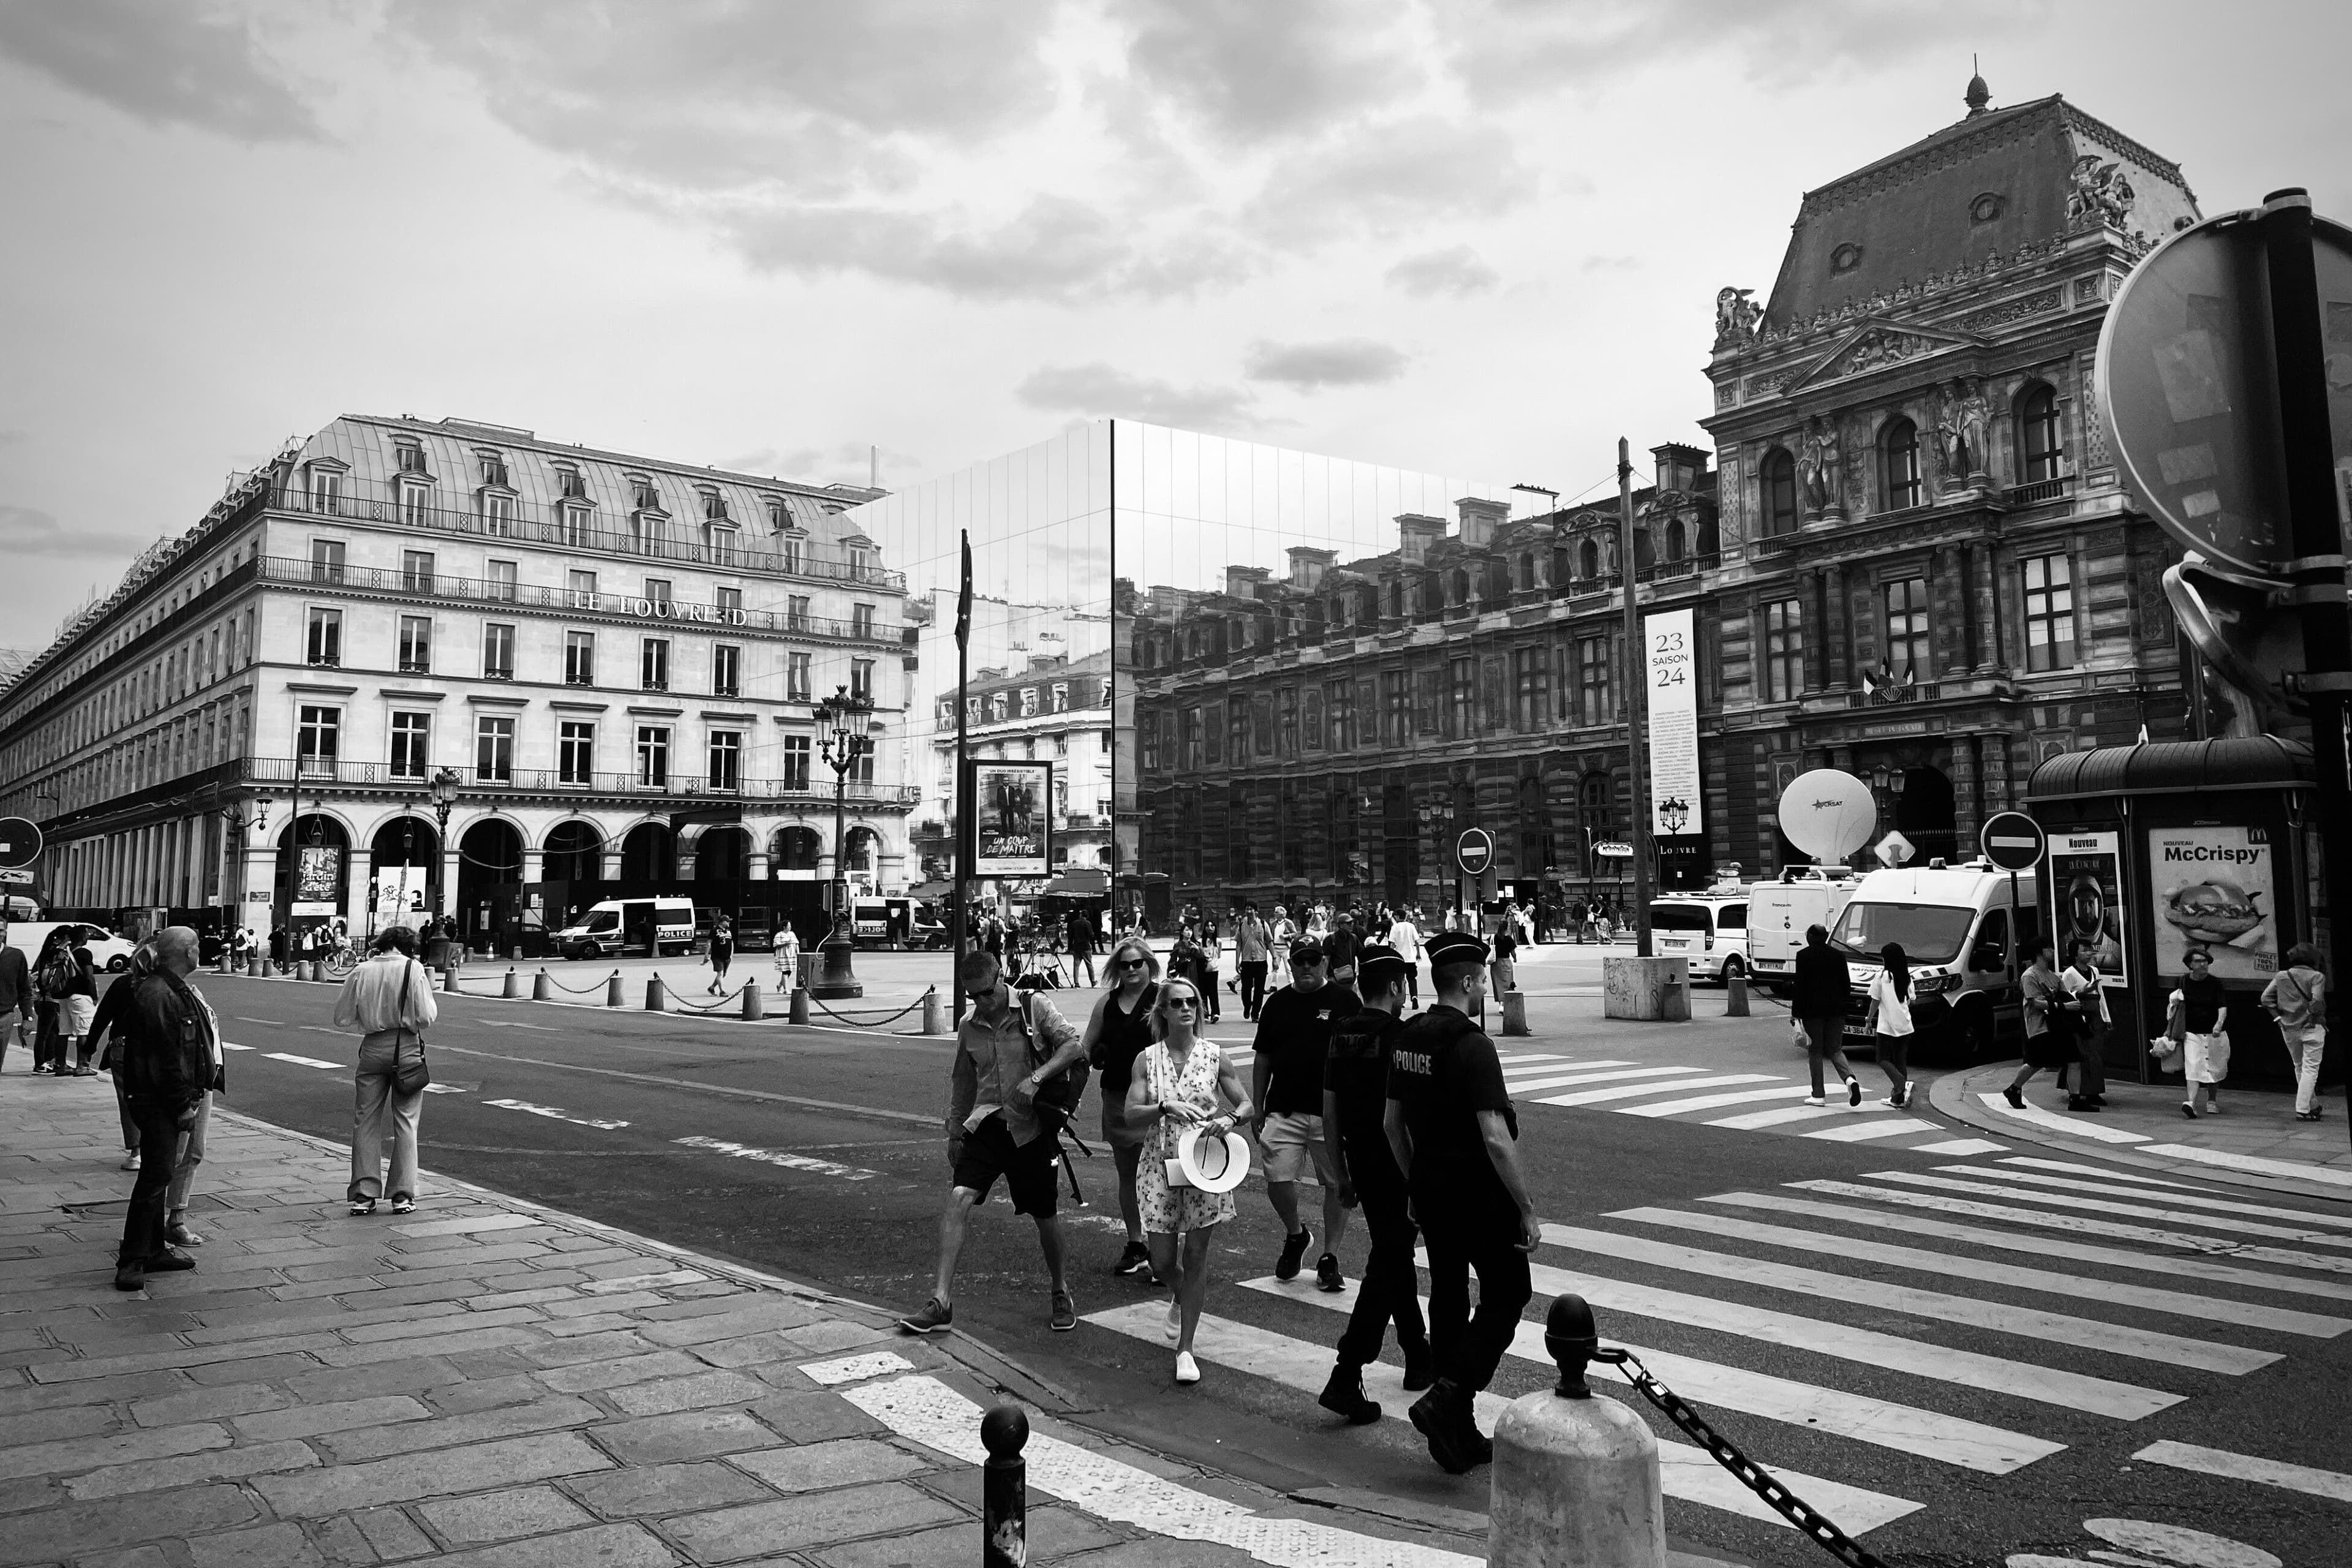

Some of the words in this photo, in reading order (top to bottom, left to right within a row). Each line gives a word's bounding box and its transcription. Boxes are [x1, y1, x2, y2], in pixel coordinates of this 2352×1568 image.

[575, 591, 601, 610] LE
[619, 597, 717, 623] LOUVRE
[1656, 633, 1683, 652] 23
[1652, 654, 1688, 666] SAISON
[1657, 668, 1686, 687] 24
[1008, 835, 1028, 845] COUP
[2069, 838, 2097, 848] Nouveau
[987, 845, 999, 853] DE
[999, 843, 1036, 855] MAÎTRE
[2165, 845, 2260, 864] McCrispy
[303, 872, 334, 883] jardin
[1396, 1049, 1432, 1075] POLICE
